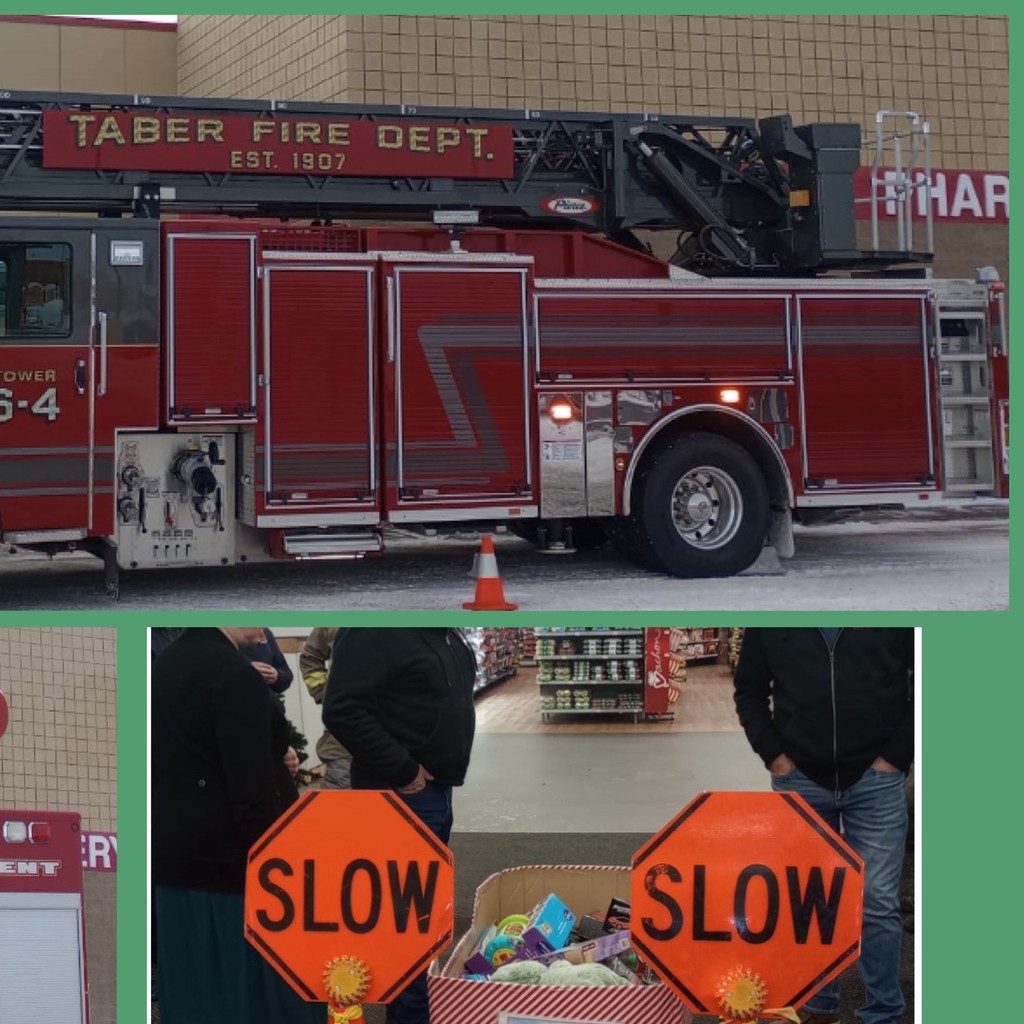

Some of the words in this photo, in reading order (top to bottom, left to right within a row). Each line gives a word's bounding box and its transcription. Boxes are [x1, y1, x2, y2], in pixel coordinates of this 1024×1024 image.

[69, 115, 224, 148] TABER
[252, 120, 351, 146] FIRE
[378, 124, 495, 160] DEPT.
[230, 151, 278, 169] EST.
[292, 153, 346, 171] 1907
[255, 857, 439, 934] SLOW
[641, 863, 847, 945] SLOW
